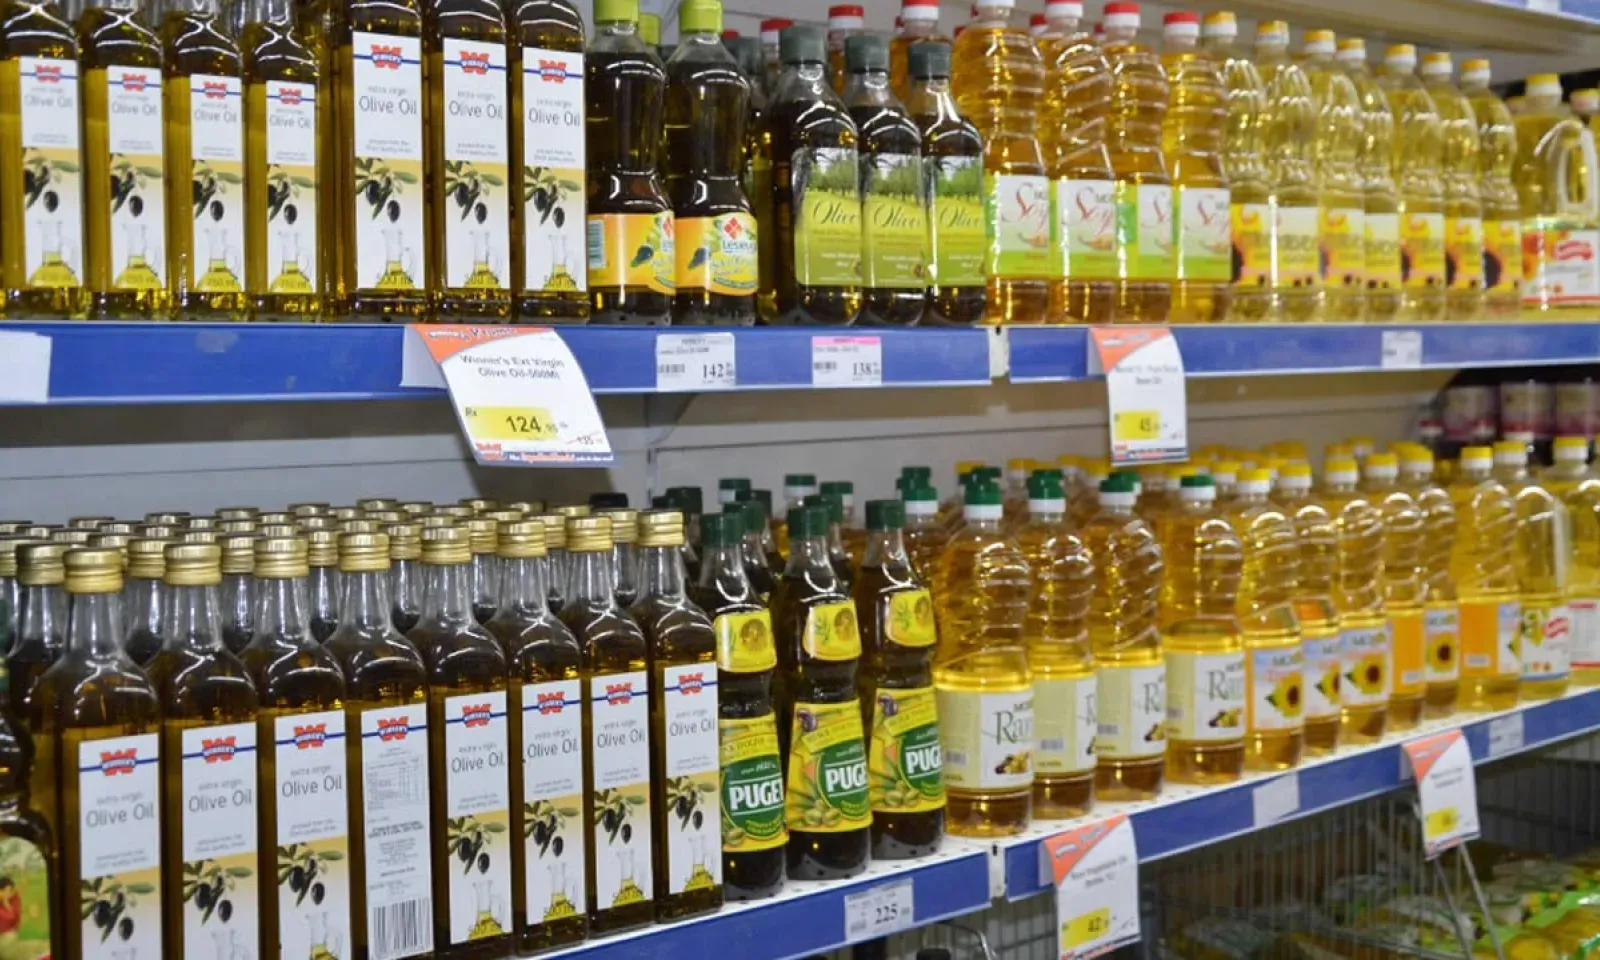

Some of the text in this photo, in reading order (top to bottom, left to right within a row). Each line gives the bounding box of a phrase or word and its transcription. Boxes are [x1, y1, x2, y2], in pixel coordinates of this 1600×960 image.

[24, 94, 54, 107] Olive
[111, 102, 139, 114] Olive
[358, 95, 417, 116] Olive Oil
[448, 99, 503, 120] Olive Oil
[193, 109, 220, 122] Olive
[269, 114, 295, 128] Olive
[528, 107, 580, 128] Olive Oil
[460, 354, 565, 369] Winner's Ext Virgin
[703, 363, 724, 379] 142
[852, 361, 873, 377] 138
[478, 367, 507, 379] Olive
[505, 415, 542, 434] 124
[669, 718, 715, 737] Olive Oil
[527, 738, 579, 759] Olive Oil
[597, 728, 645, 749] Olive Oil
[450, 751, 506, 774] Olive Oil
[281, 774, 343, 798] Olive Oil
[188, 789, 253, 813] Olive Oil
[85, 801, 156, 829] Olive Oil
[875, 903, 898, 925] 225
